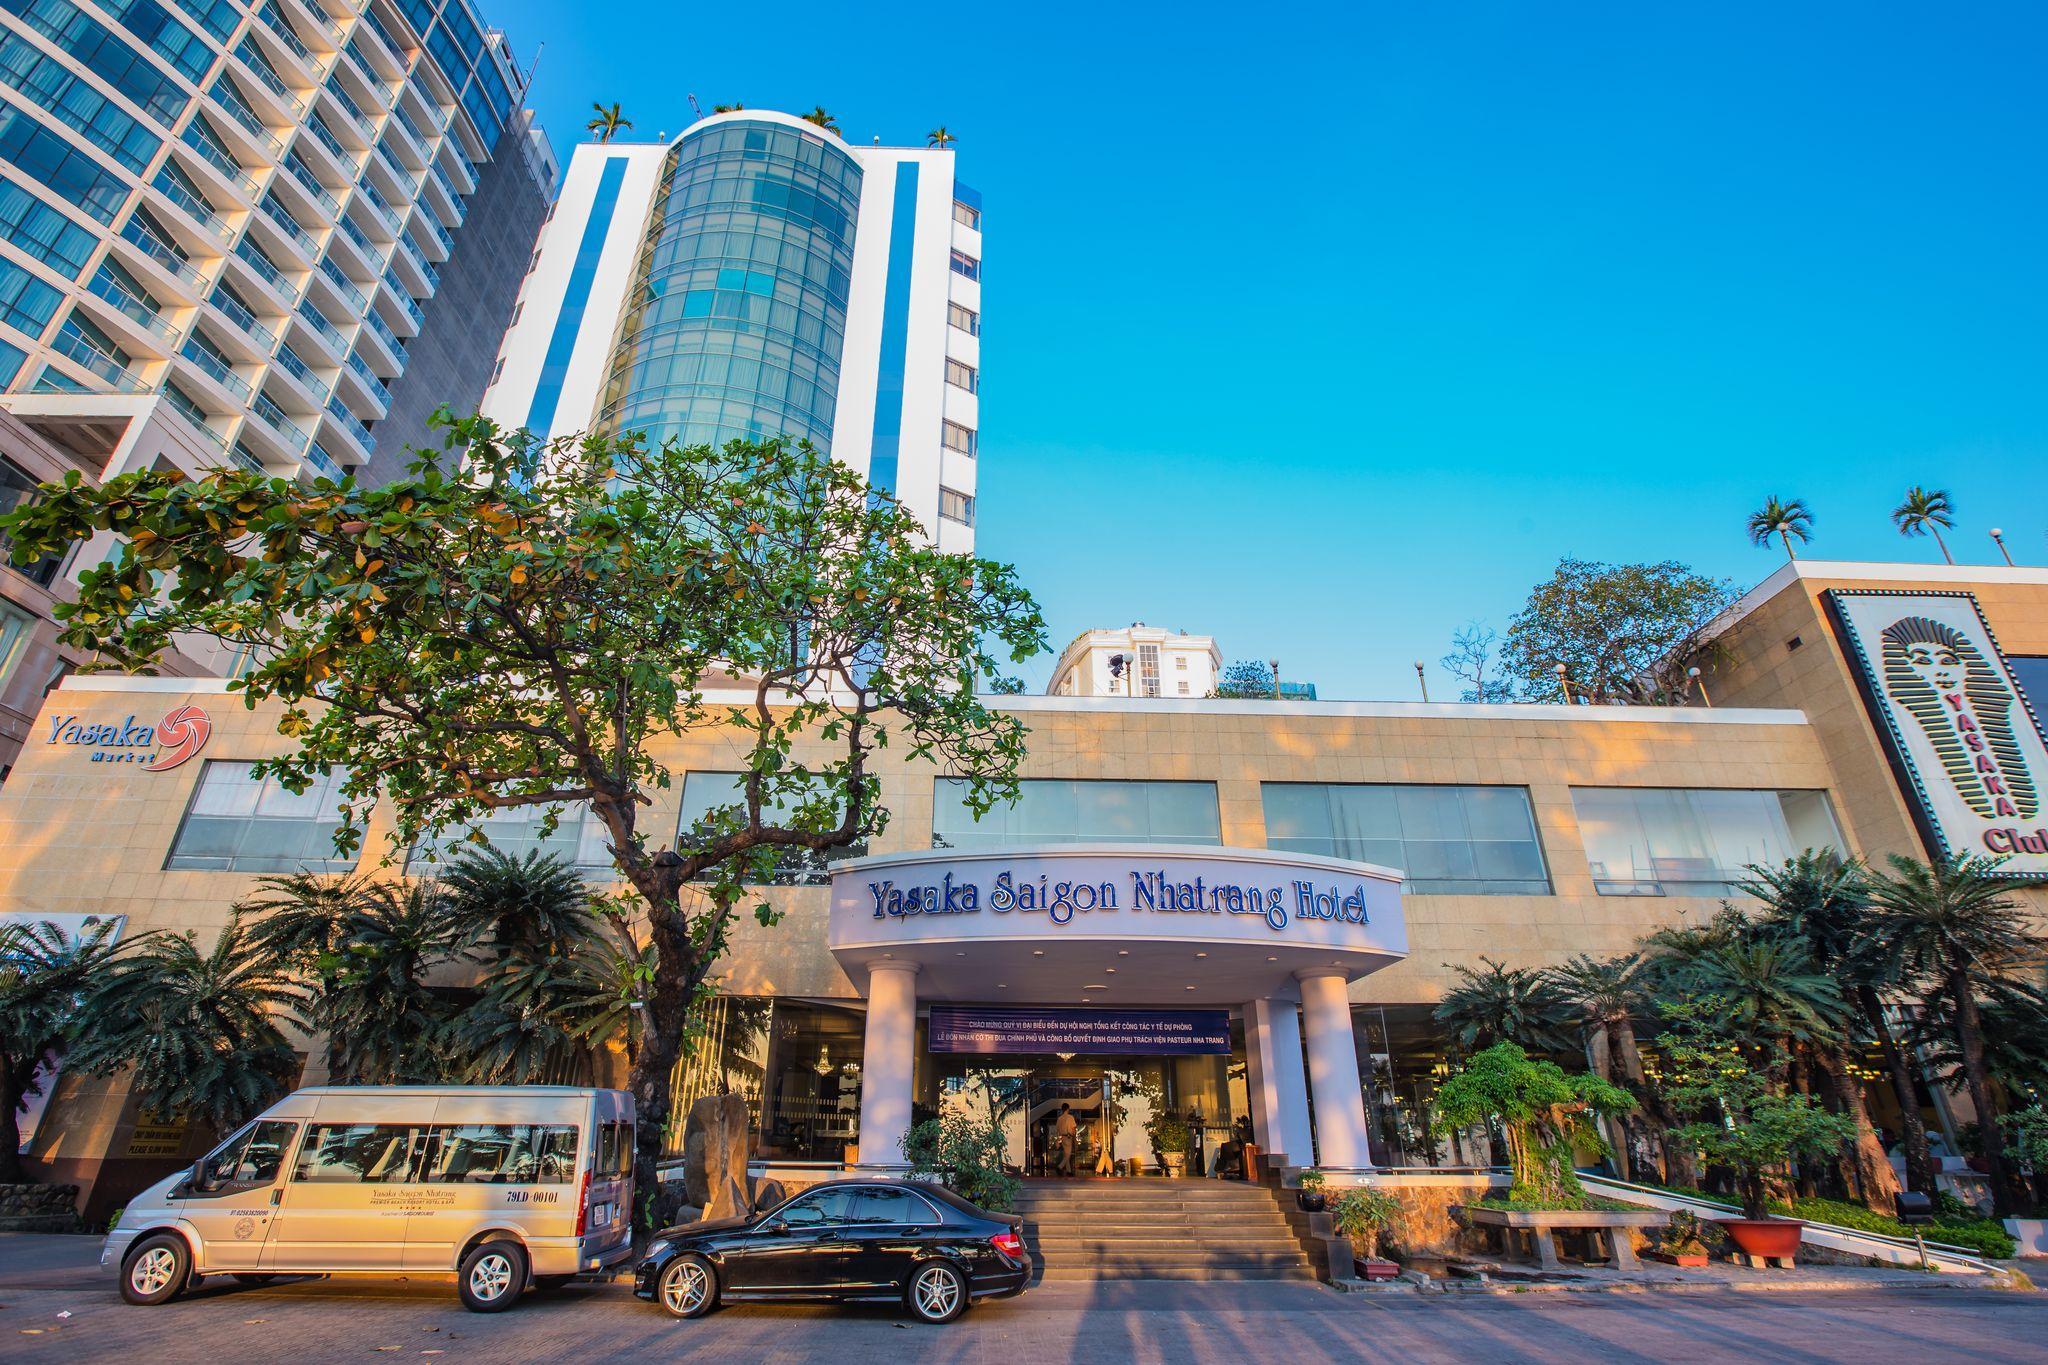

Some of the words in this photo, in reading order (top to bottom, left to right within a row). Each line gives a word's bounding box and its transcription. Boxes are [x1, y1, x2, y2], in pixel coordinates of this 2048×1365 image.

[46, 713, 154, 747] Yasaka
[90, 751, 156, 764] Market
[1944, 693, 2018, 818] YASAKA
[868, 872, 980, 919] Yasaka
[990, 871, 1121, 926] Saigon
[1130, 870, 1289, 931] Nhatrang
[1292, 879, 1372, 925] Hotel
[1167, 1036, 1192, 1044] PASTEUR
